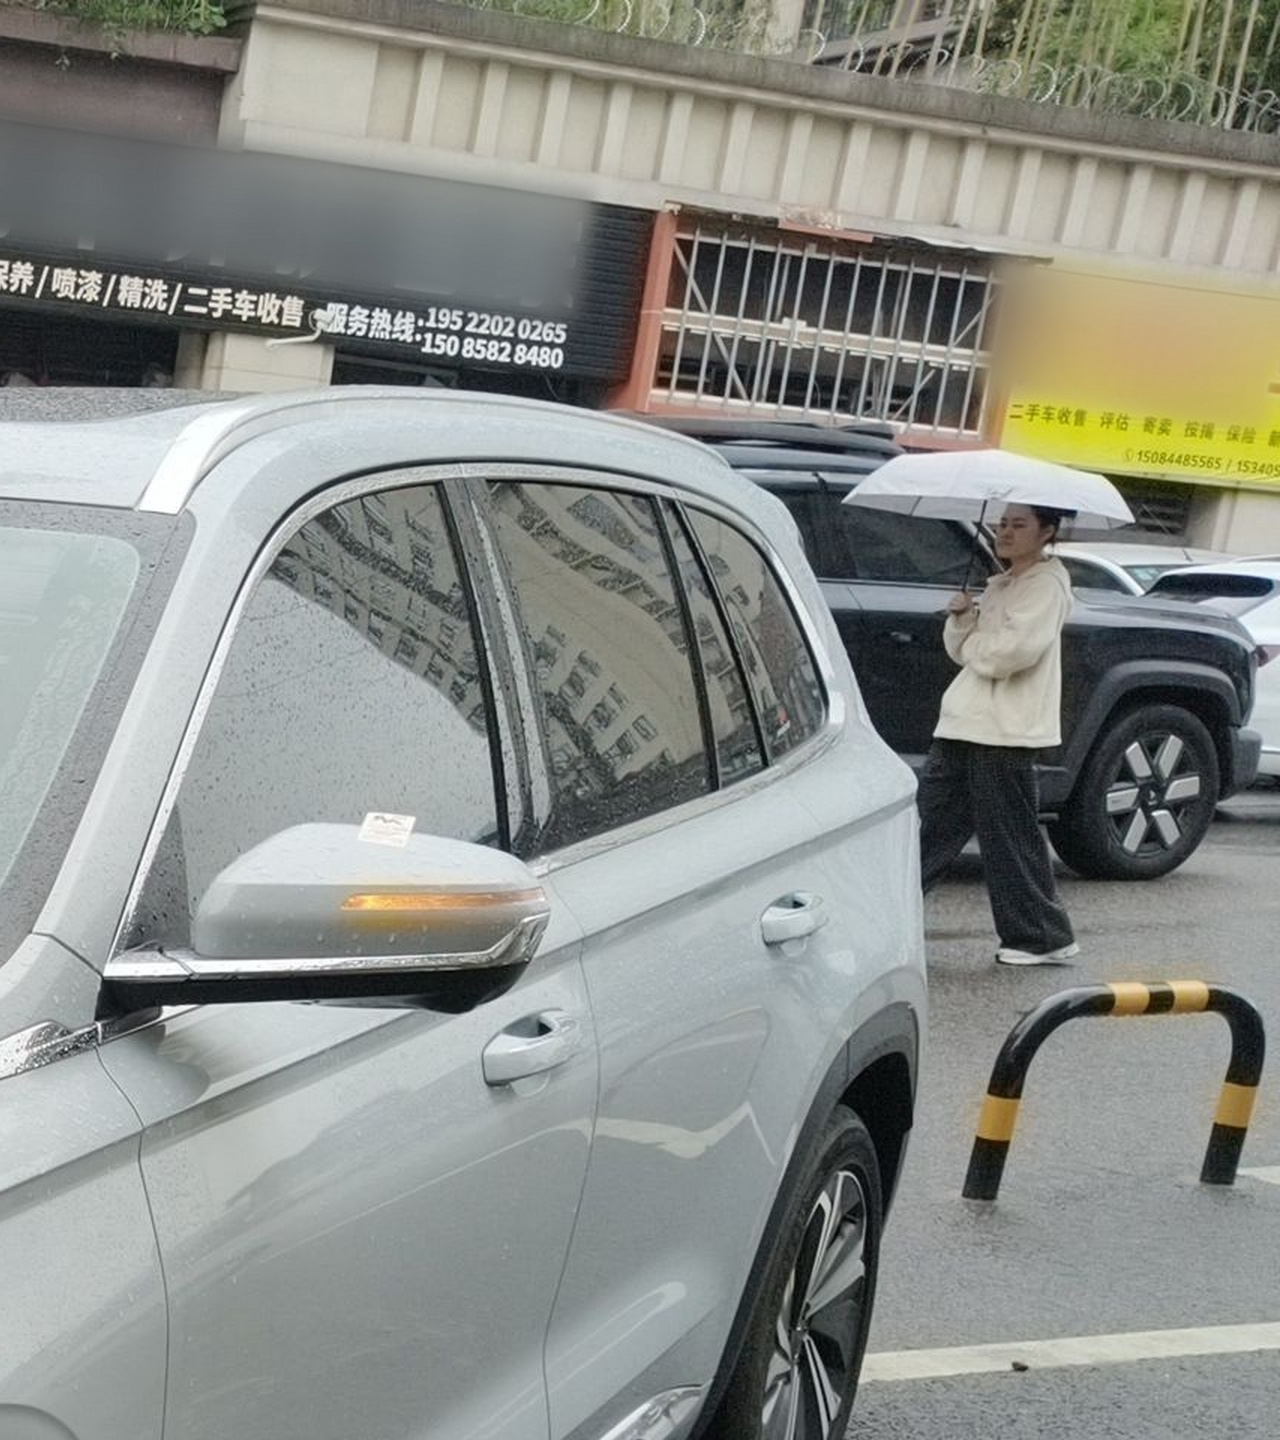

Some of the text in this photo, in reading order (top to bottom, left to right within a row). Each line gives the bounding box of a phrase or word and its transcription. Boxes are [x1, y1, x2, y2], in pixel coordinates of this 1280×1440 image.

[425, 307, 568, 344] 195 2202 0265
[421, 332, 564, 369] 150 8582 8480
[1009, 402, 1088, 428] 二手车收售
